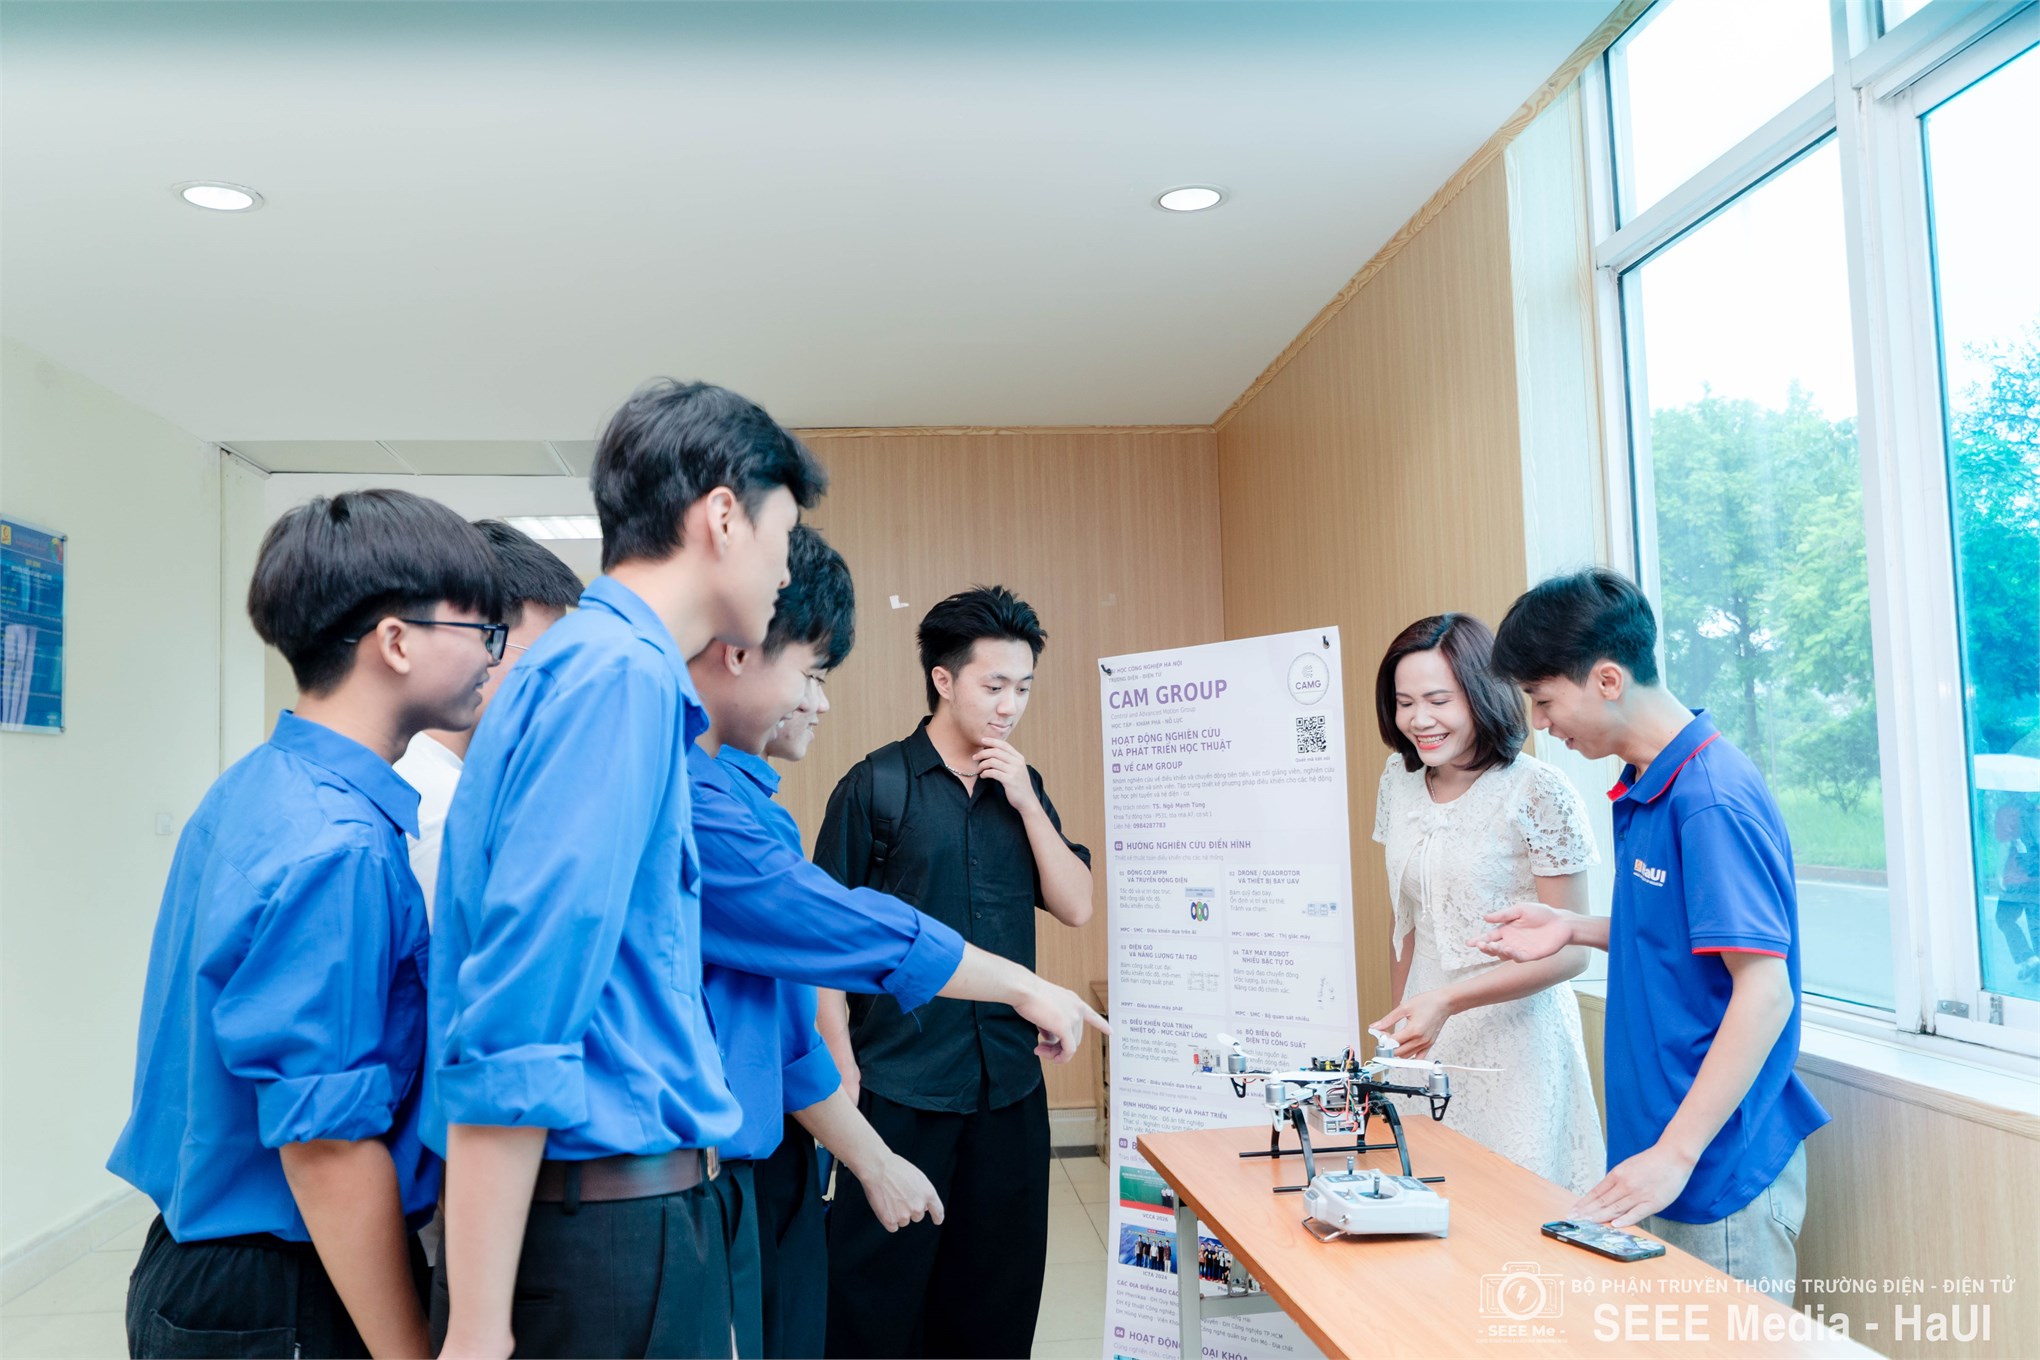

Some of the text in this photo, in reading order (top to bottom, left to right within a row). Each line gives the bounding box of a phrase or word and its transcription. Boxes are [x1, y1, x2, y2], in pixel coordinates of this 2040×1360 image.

[1295, 680, 1321, 690] CAMG
[1109, 679, 1228, 710] CAM GROUP
[1139, 708, 1162, 718] Advanced
[1163, 707, 1179, 715] Motion
[1180, 706, 1196, 715] Group
[1112, 727, 1221, 747] HOẠT ĐỘNG NGHIÊN CỨU
[1112, 740, 1232, 757] VÀ PHÁT TRIỂN HỌC THUẬT
[1124, 761, 1183, 772] VỀ CAM GROUP
[1126, 837, 1251, 850] HƯỚNG NGHIÊN CỨU ĐIỂN HÌNH
[1269, 950, 1290, 958] ROBOT
[1129, 1330, 1155, 1345] HOẠT
[1158, 1336, 1180, 1350] ĐỘN
[1201, 1346, 1219, 1359] OẠI
